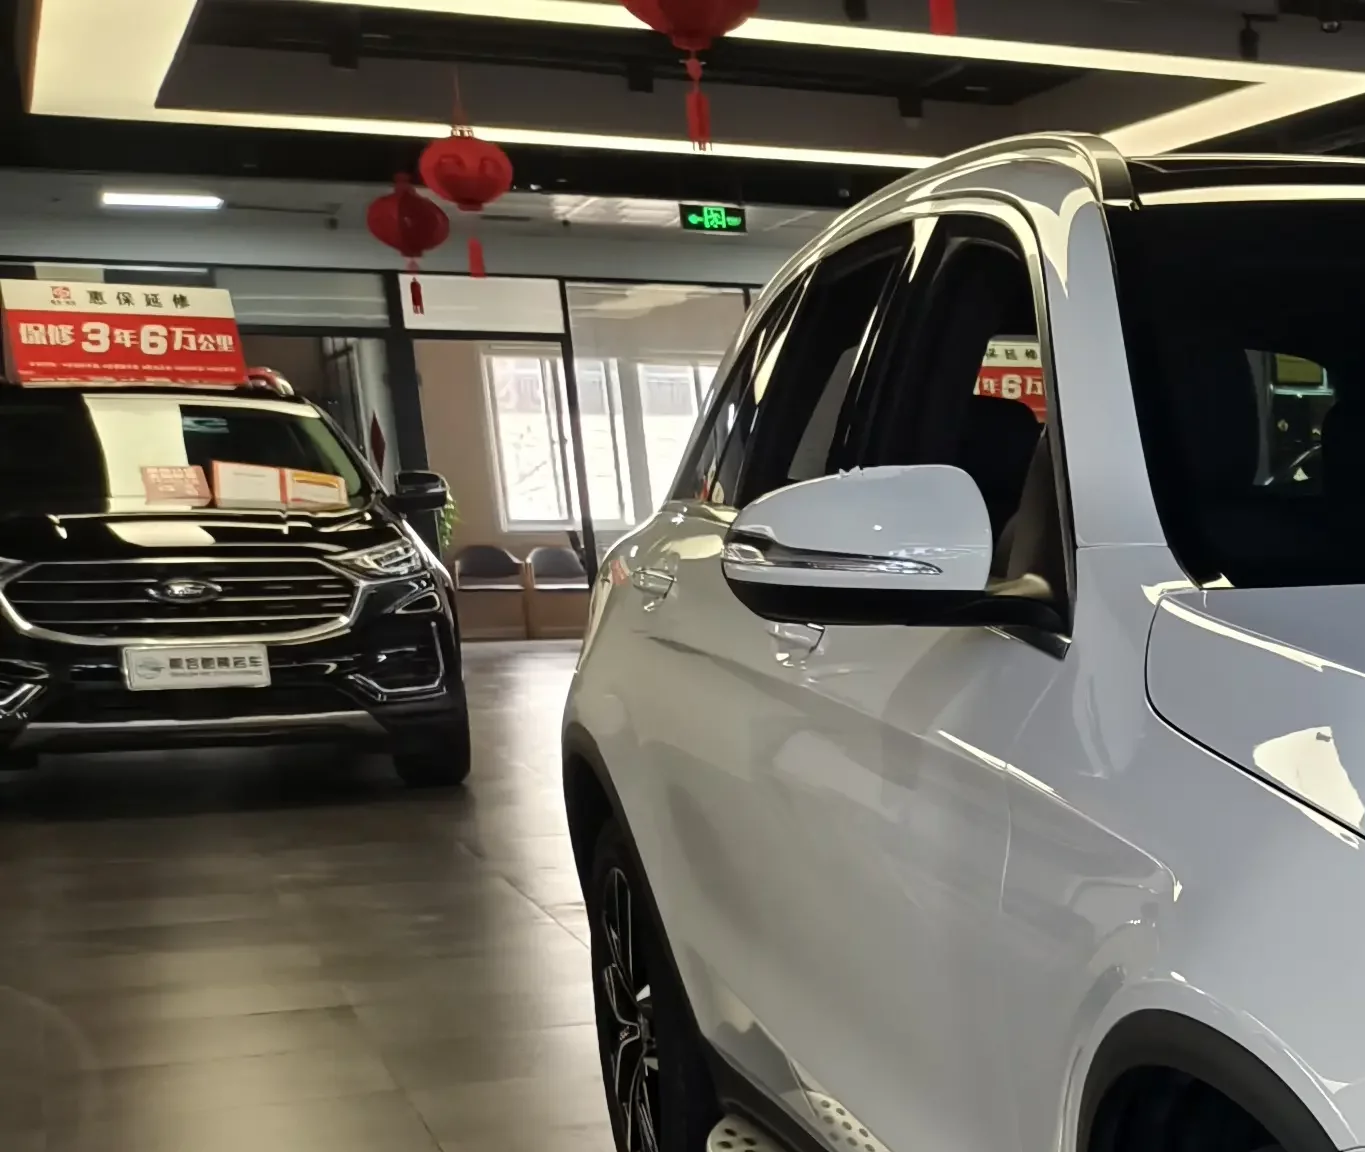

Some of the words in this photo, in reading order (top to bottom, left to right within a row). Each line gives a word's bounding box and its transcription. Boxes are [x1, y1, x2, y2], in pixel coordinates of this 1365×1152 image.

[19, 321, 235, 355] 保修3年6万公里
